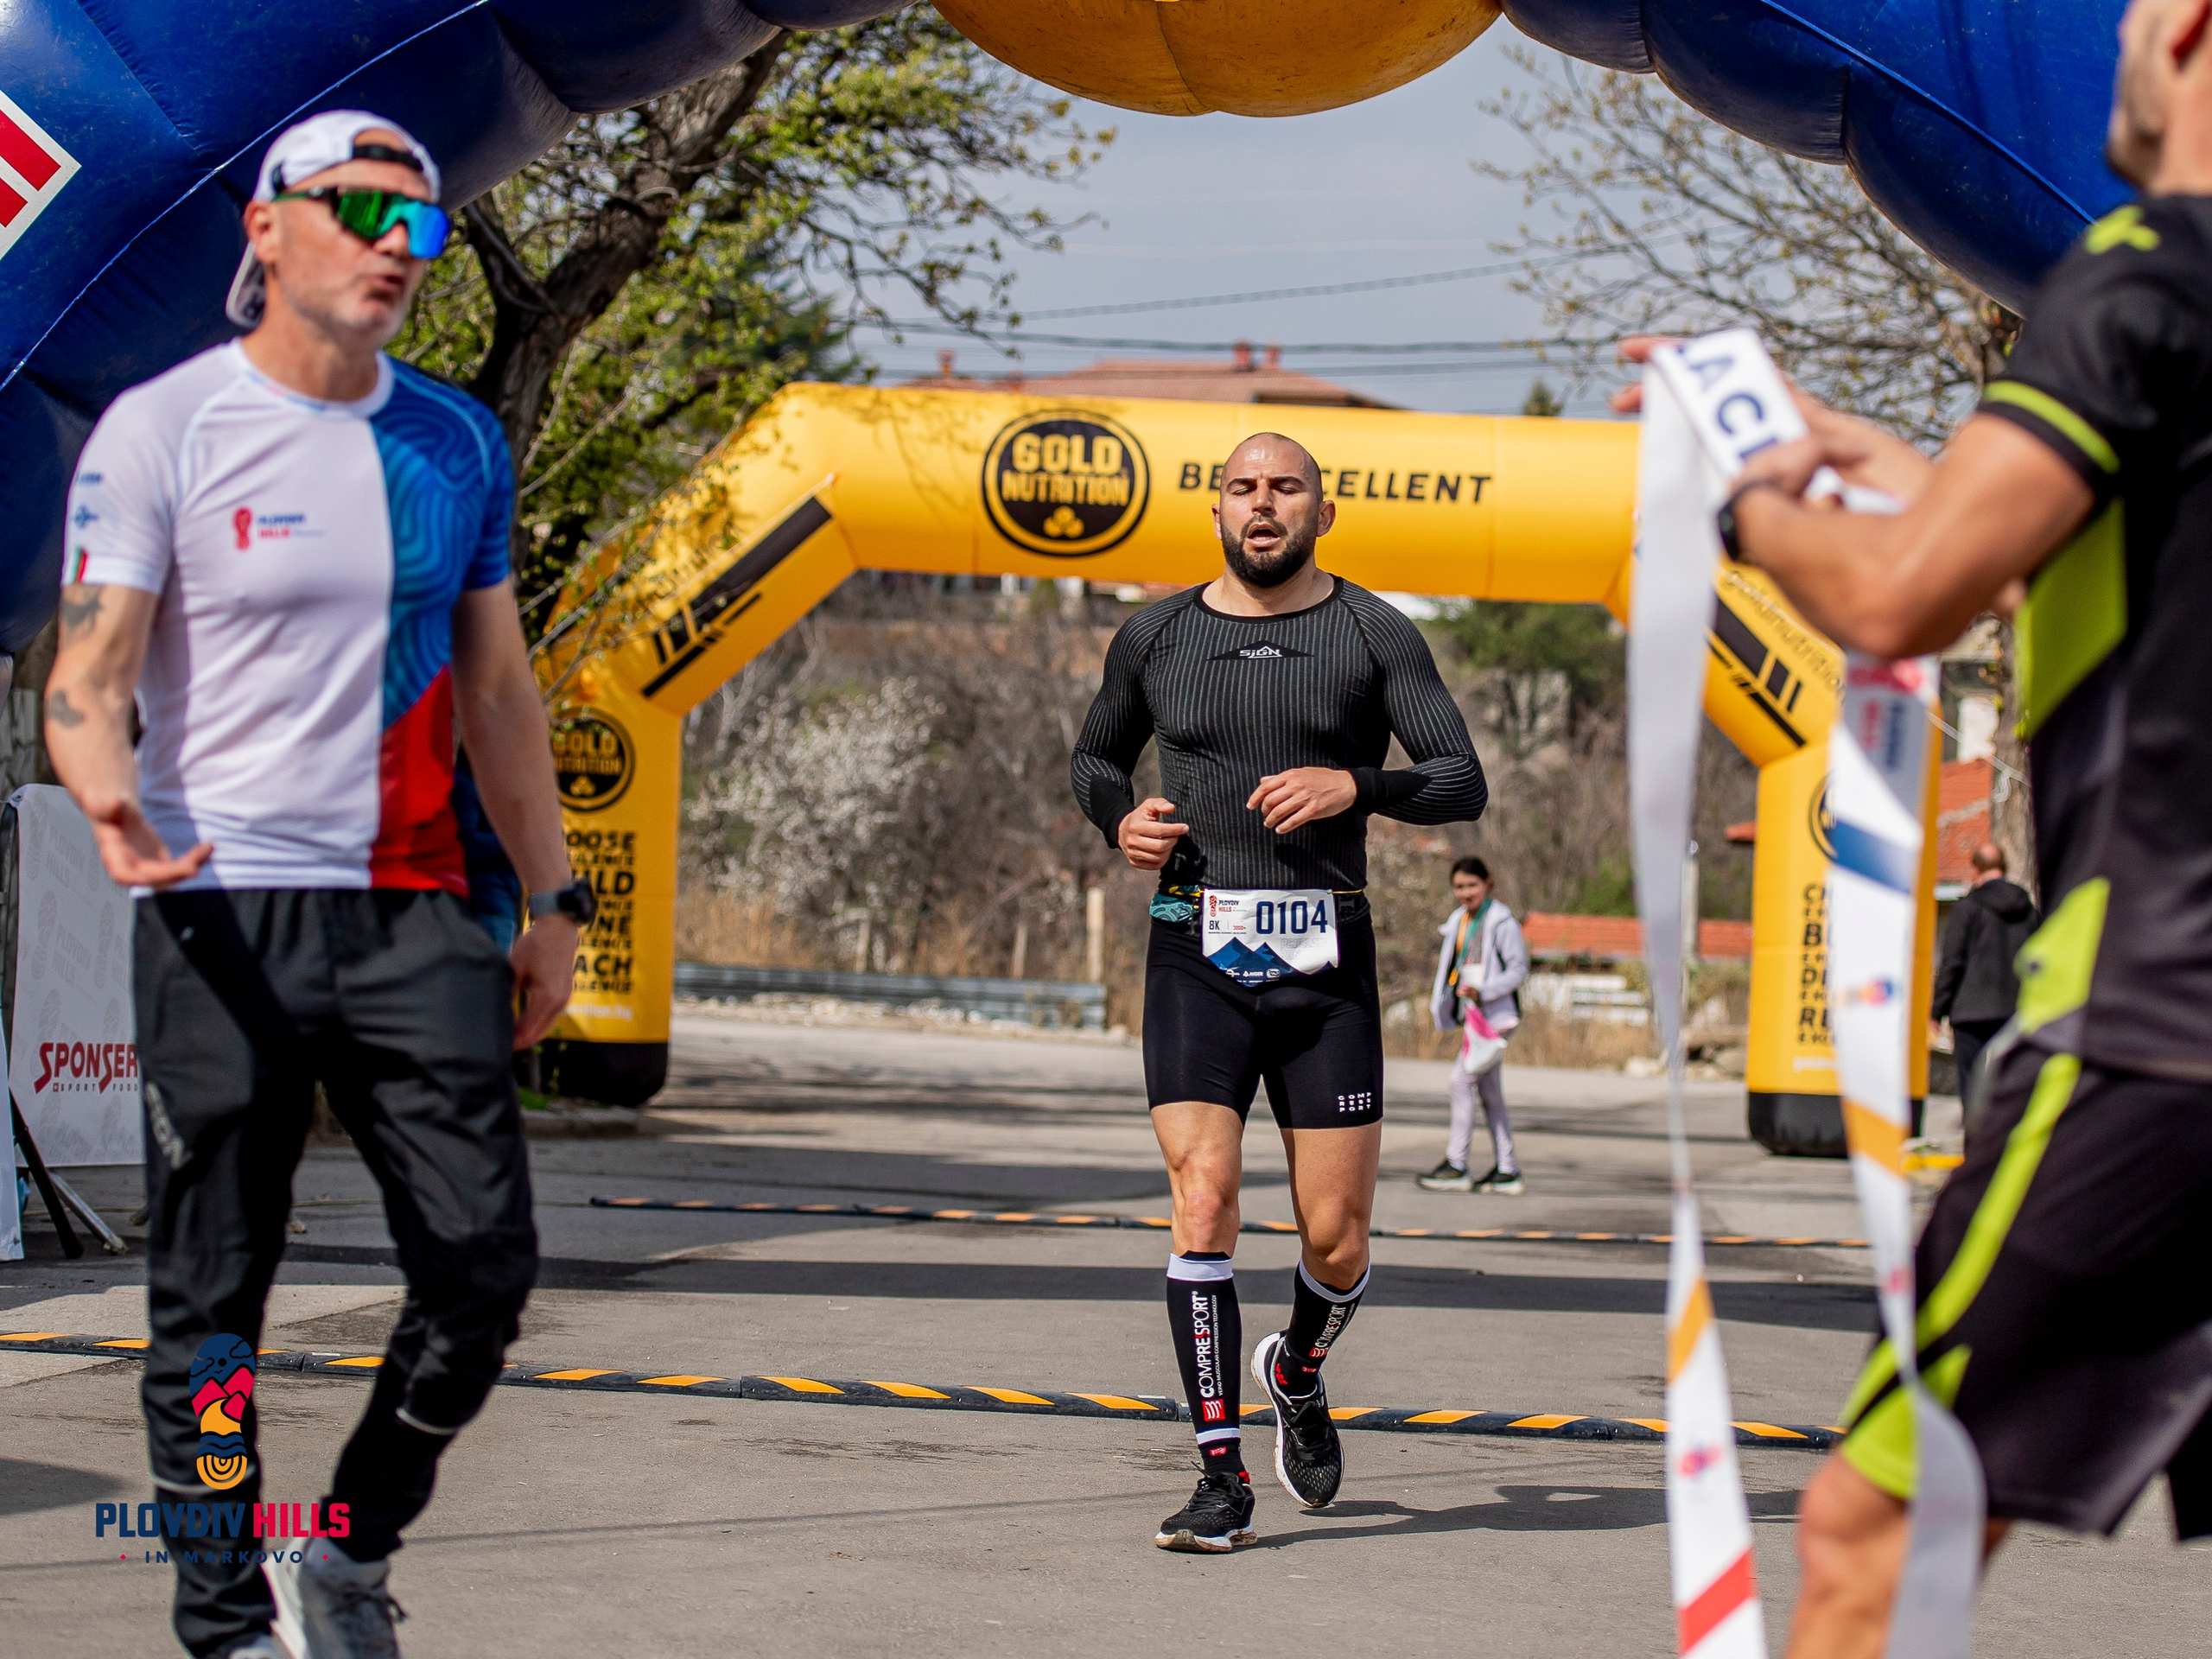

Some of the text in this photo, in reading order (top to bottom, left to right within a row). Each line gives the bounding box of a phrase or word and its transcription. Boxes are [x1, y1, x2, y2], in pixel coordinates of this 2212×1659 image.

[1013, 433, 1123, 474] GOLD
[1002, 470, 1130, 506] NUTRITION
[567, 831, 636, 851] OOSE
[1209, 919, 1220, 931] 8K
[1255, 899, 1329, 935] 0104
[34, 1041, 138, 1094] SPONSER
